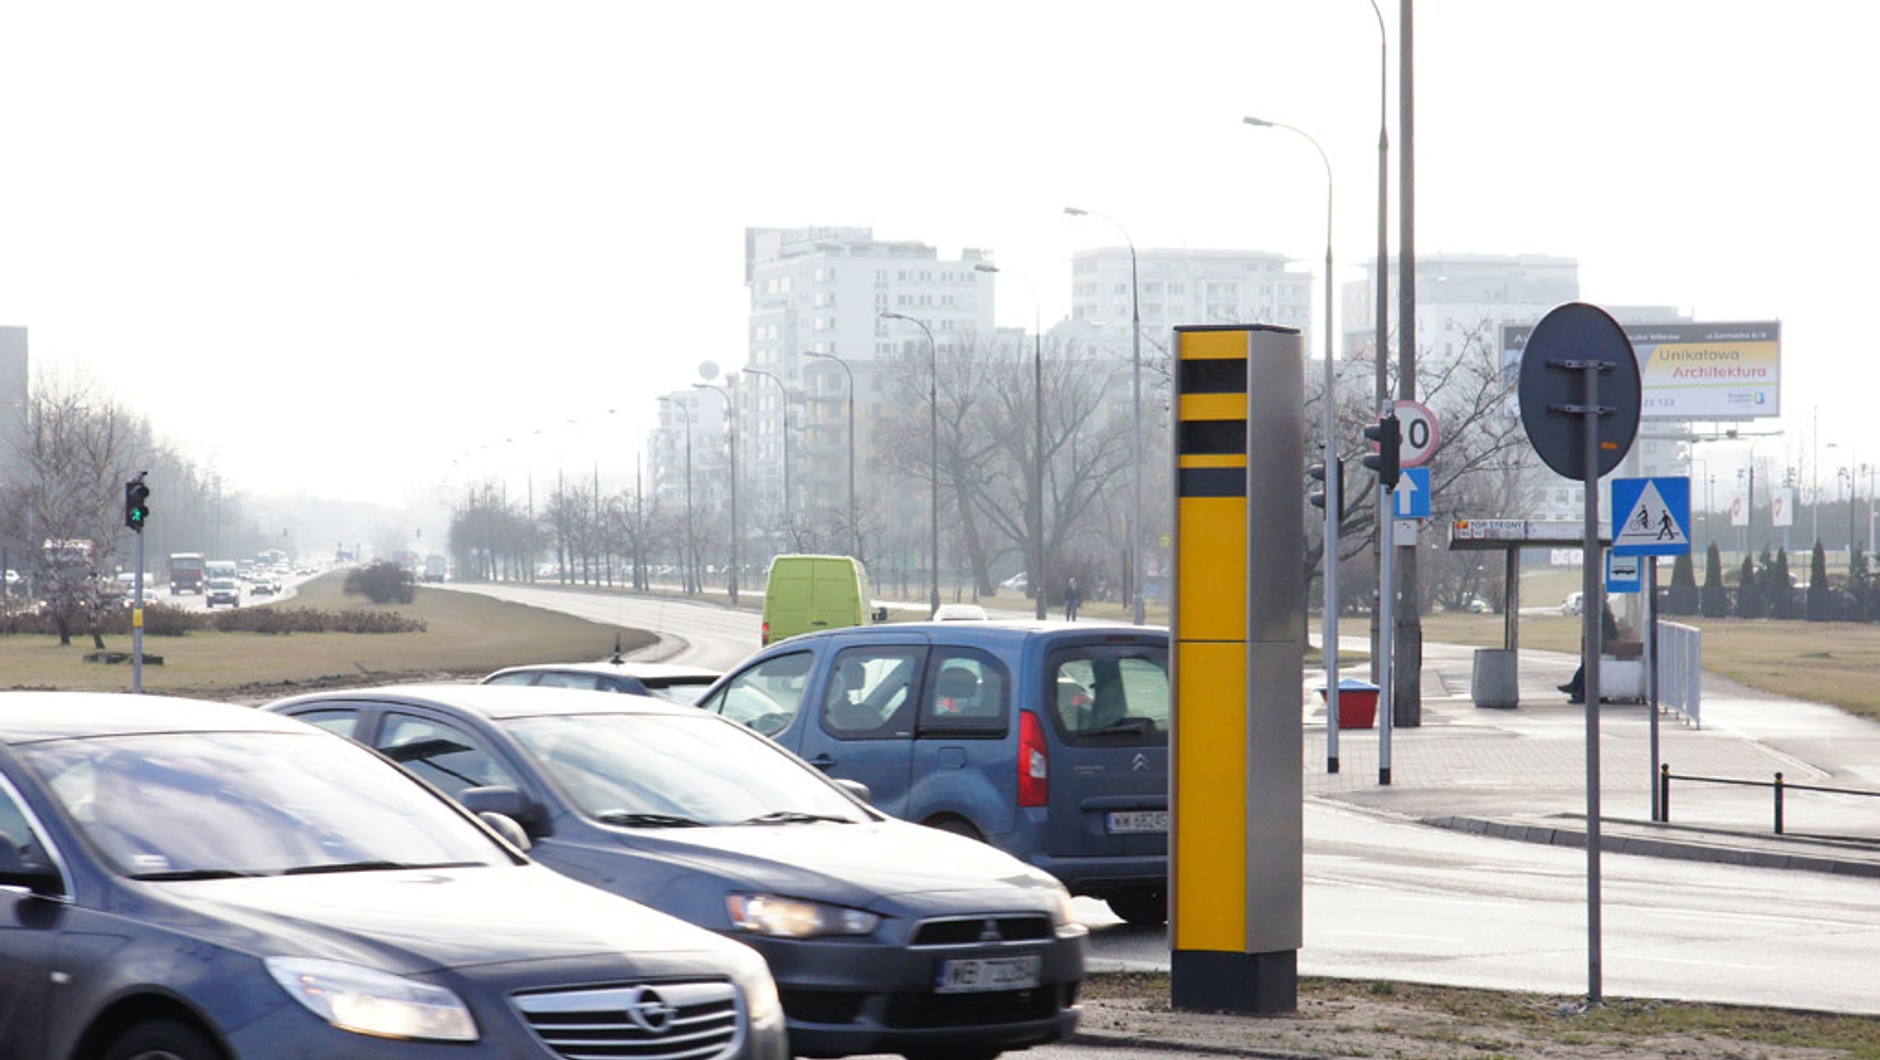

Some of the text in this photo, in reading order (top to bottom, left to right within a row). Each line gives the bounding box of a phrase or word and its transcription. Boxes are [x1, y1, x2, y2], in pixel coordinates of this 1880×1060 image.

[1659, 349, 1740, 361] Unikatowa
[1672, 365, 1767, 378] Architektura
[1409, 418, 1430, 449] 0
[1489, 520, 1522, 529] STEGNY
